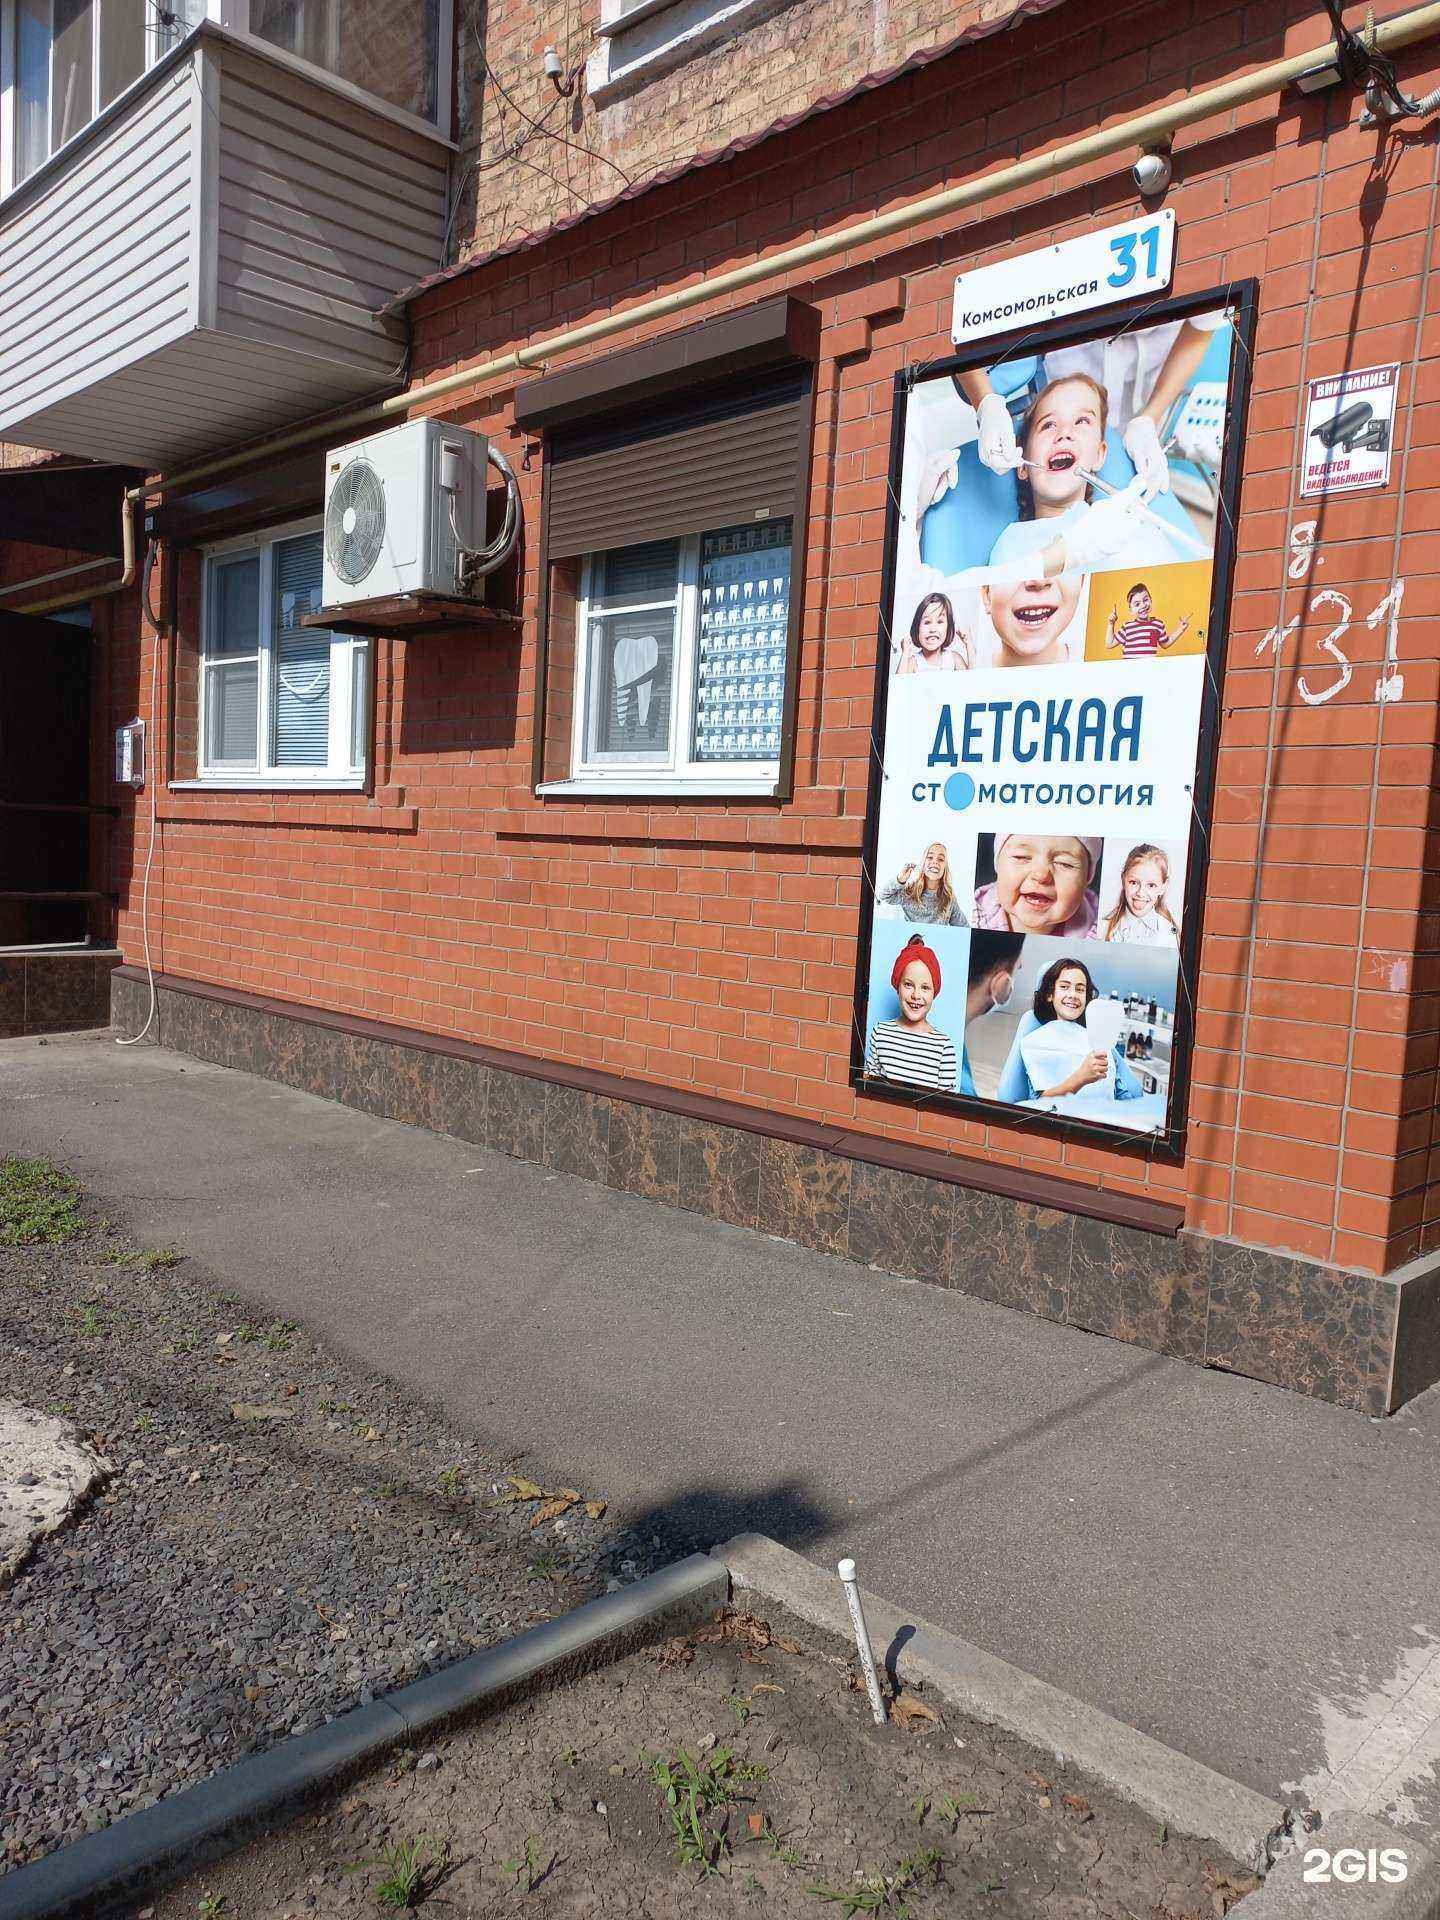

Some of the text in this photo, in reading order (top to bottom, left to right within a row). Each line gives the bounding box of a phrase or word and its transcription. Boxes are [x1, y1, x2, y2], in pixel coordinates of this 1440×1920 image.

[961, 225, 1161, 329] Комсомольская 31
[1306, 469, 1384, 490] ВИДЕОНАБЛЮДЕНИЕ
[1308, 459, 1351, 477] ВЕДЕТСЯ
[927, 695, 1144, 768] ДЕТСКАЯ
